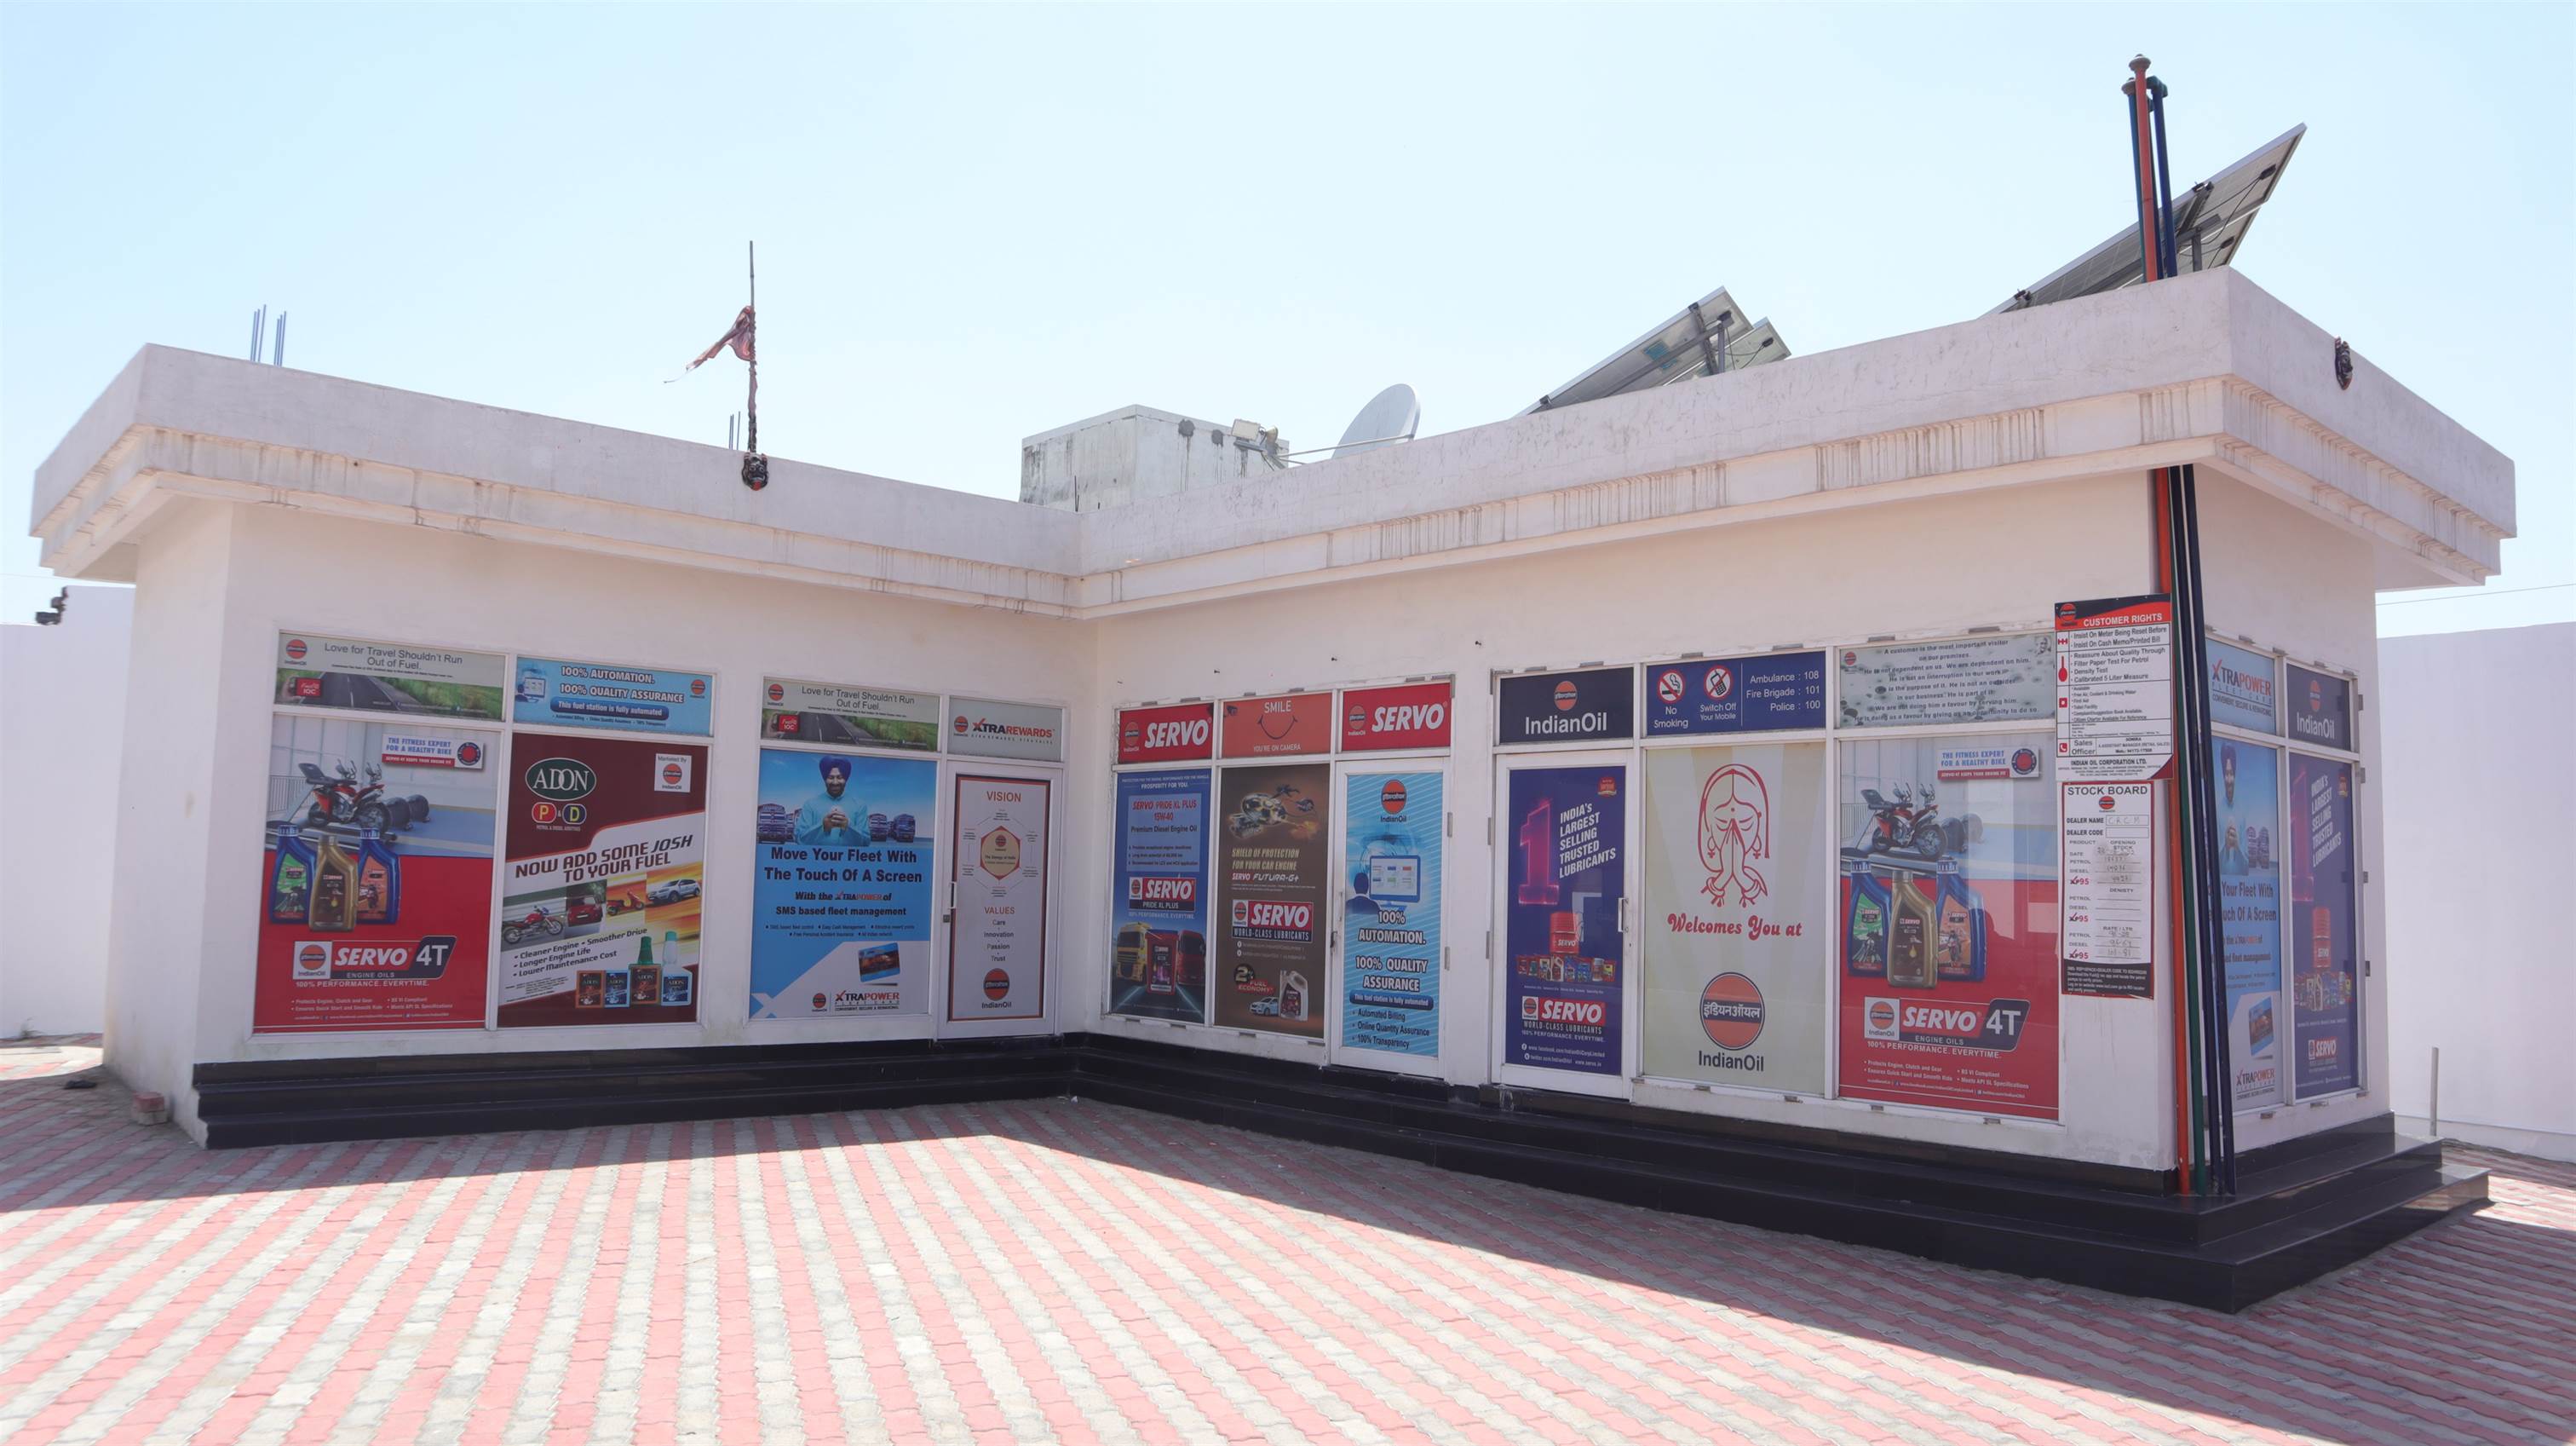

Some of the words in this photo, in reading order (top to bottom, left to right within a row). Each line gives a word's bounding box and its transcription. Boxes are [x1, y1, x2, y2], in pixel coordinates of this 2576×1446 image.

[2084, 616, 2129, 626] CUSTOMER
[2131, 614, 2162, 622] RIGHTS
[325, 643, 348, 653] Love
[351, 644, 363, 655] for
[367, 647, 396, 658] Travel
[398, 649, 441, 662] Shouldn't
[444, 654, 463, 664] Run
[367, 657, 384, 666] Out
[387, 658, 396, 667] of
[399, 659, 422, 670] Fuel.
[561, 665, 587, 677] 100%
[1750, 673, 1795, 684] Ambulance
[1803, 671, 1819, 681] 108
[560, 683, 587, 695] 100%
[589, 686, 629, 698] QUALITY
[631, 689, 684, 703] ASSURANCE
[802, 686, 821, 695] Love
[823, 688, 834, 697] for
[836, 688, 860, 700] Travel
[861, 691, 896, 702] Shouldn't
[900, 695, 915, 704] Run
[1746, 689, 1762, 699] Fire
[1764, 687, 1795, 699] Brigade
[1805, 686, 1820, 695] 101
[837, 699, 850, 707] Out
[853, 700, 860, 709] of
[862, 700, 880, 711] Fuel.
[1264, 700, 1291, 714] SMILE
[1665, 706, 1677, 715] No
[1699, 704, 1722, 713] Switch
[1770, 701, 1795, 711] Police
[1804, 700, 1820, 710] 100
[1371, 703, 1445, 733] SERVO
[1525, 713, 1607, 735] IndianOil
[1654, 718, 1688, 729] Smoking
[1700, 712, 1714, 721] Your
[1715, 712, 1736, 721] Mobile
[1144, 719, 1209, 749] SERVO
[2297, 712, 2334, 740] IndianOil
[533, 769, 589, 791] ADON
[986, 791, 1021, 802] VISION
[2108, 786, 2148, 794] BOARD
[539, 804, 549, 820] P
[570, 807, 580, 821] D
[1561, 812, 1601, 837] LARGEST
[1560, 827, 1597, 850] SELLING
[515, 859, 558, 878] NOW
[563, 852, 596, 869] ADD
[601, 842, 648, 861] SOME
[652, 834, 693, 852] JOSH
[771, 847, 808, 861] Move
[813, 848, 843, 861] Your
[848, 850, 882, 862] Fleet
[888, 850, 917, 863] With
[1560, 840, 1599, 864] TRUSTED
[564, 868, 588, 882] TO
[589, 859, 630, 878] YOUR
[636, 852, 670, 868] FUEL
[1559, 848, 1616, 879] LUBRICANTS
[765, 867, 791, 879] The
[796, 868, 837, 881] Touch
[842, 869, 858, 881] Of
[862, 870, 871, 881] A
[876, 869, 922, 883] Screen
[1146, 880, 1192, 900] SERVO
[2239, 882, 2257, 895] Fleet
[2257, 884, 2273, 898] With
[850, 907, 906, 917] management
[1251, 903, 1309, 928] SERVO
[1378, 910, 1406, 924] 100%
[2254, 907, 2276, 921] Screen
[1234, 928, 1272, 938] WORLD-CLASS
[1274, 930, 1308, 941] LUBRICANTS
[1668, 913, 1742, 935] Welcomes
[1749, 915, 1780, 940] You
[1785, 923, 1802, 936] at
[587, 932, 625, 946] Smoother
[627, 928, 647, 936] Drive
[1358, 929, 1426, 944] AUTOMATION.
[335, 948, 408, 966] SERVO
[417, 945, 448, 965] 4T
[520, 948, 551, 959] Cleaner
[553, 942, 579, 953] Engine
[520, 957, 547, 969] Longer
[549, 950, 575, 962] Engine
[577, 947, 591, 956] Life
[519, 967, 544, 976] Lower
[546, 955, 598, 971] Maintenance
[600, 950, 617, 959] Cost
[1355, 956, 1383, 970] 100%
[1386, 958, 1428, 972] QUALITY
[1363, 976, 1420, 992] ASSURANCE
[1358, 1009, 1387, 1018] Automated
[1388, 1011, 1405, 1021] Billing
[1542, 1000, 1601, 1023] SERVO
[1704, 1002, 1760, 1018] इंडियनऑयल
[1358, 1022, 1374, 1030] Online
[1376, 1023, 1399, 1033] Quantity
[1400, 1025, 1429, 1036] Assurance
[1903, 1006, 1976, 1032] SERVO
[1987, 1010, 2021, 1036] 4T
[1358, 1034, 1371, 1044] 100%
[1373, 1036, 1410, 1048] Transparency
[2315, 1040, 2337, 1057] SERVO
[1888, 1042, 1950, 1055] PERFORMANCE.
[1952, 1048, 2001, 1058] EVERYTIME.
[1699, 1051, 1764, 1072] IndianOil
